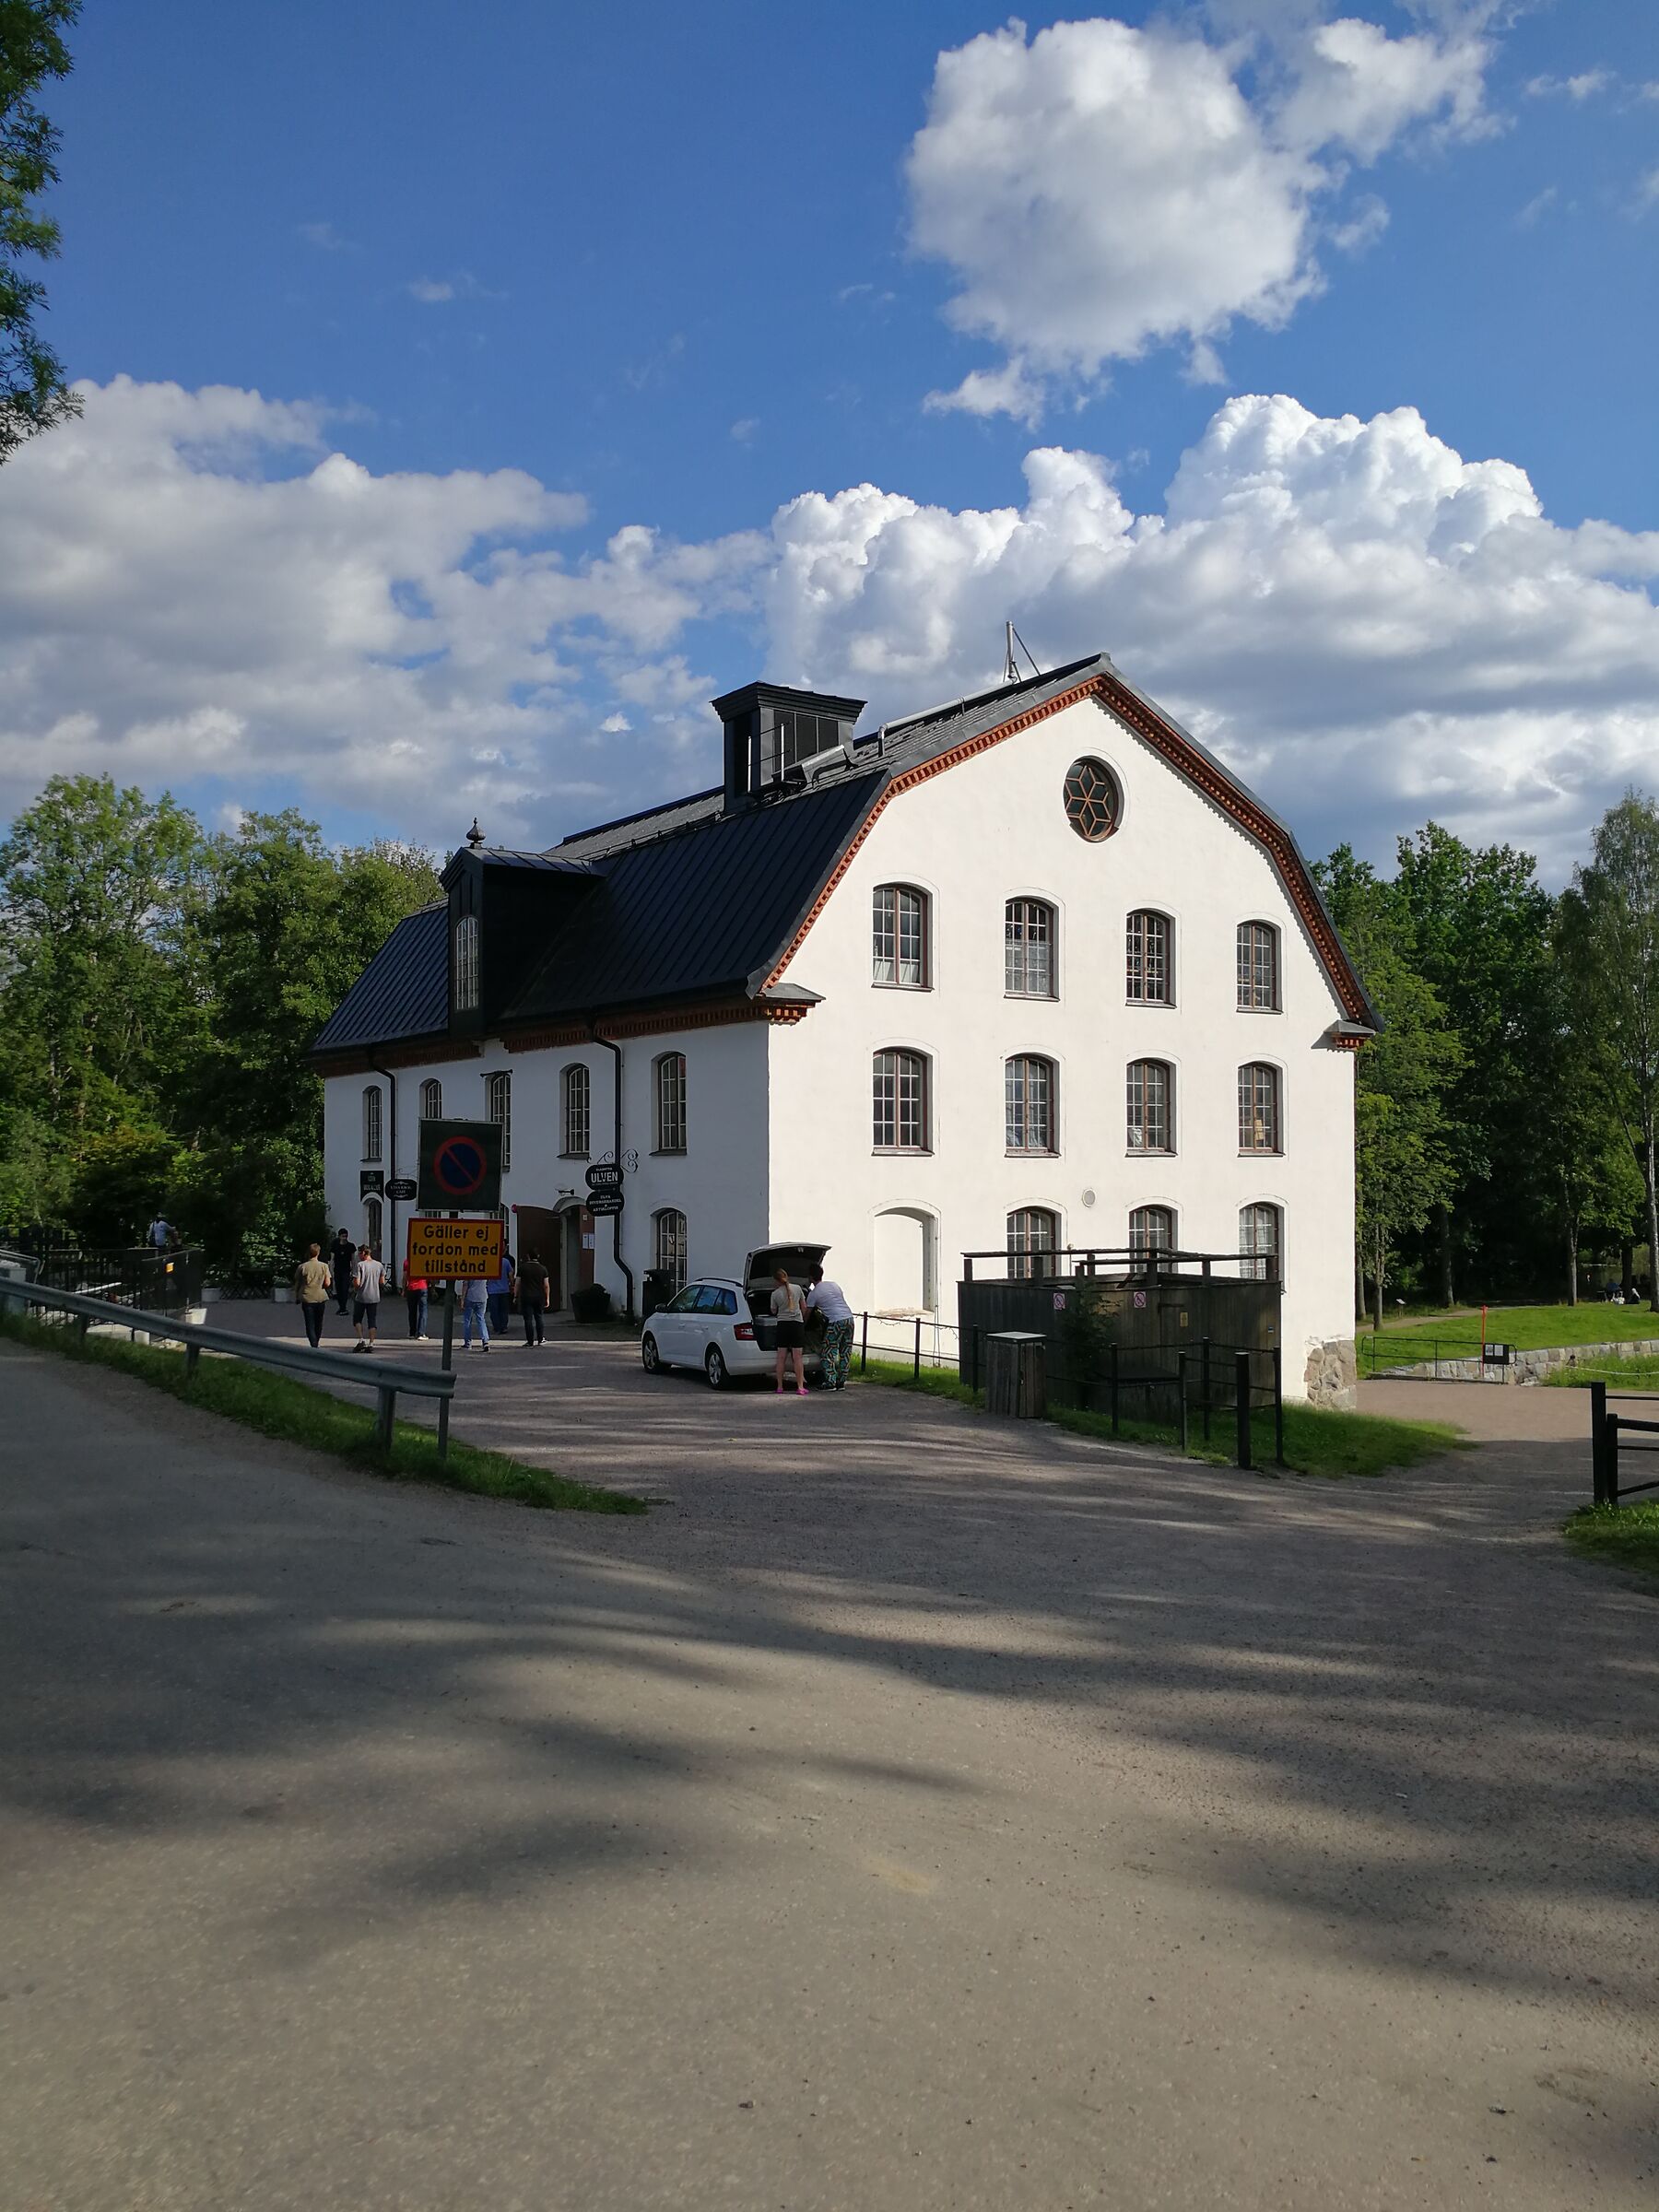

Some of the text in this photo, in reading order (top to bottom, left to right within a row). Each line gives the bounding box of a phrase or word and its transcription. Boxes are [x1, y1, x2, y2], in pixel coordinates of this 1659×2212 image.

[591, 1171, 618, 1183] ULVEN
[424, 1225, 488, 1241] Gäller ej
[412, 1241, 499, 1255] fordon med
[425, 1259, 486, 1273] tillstånd
